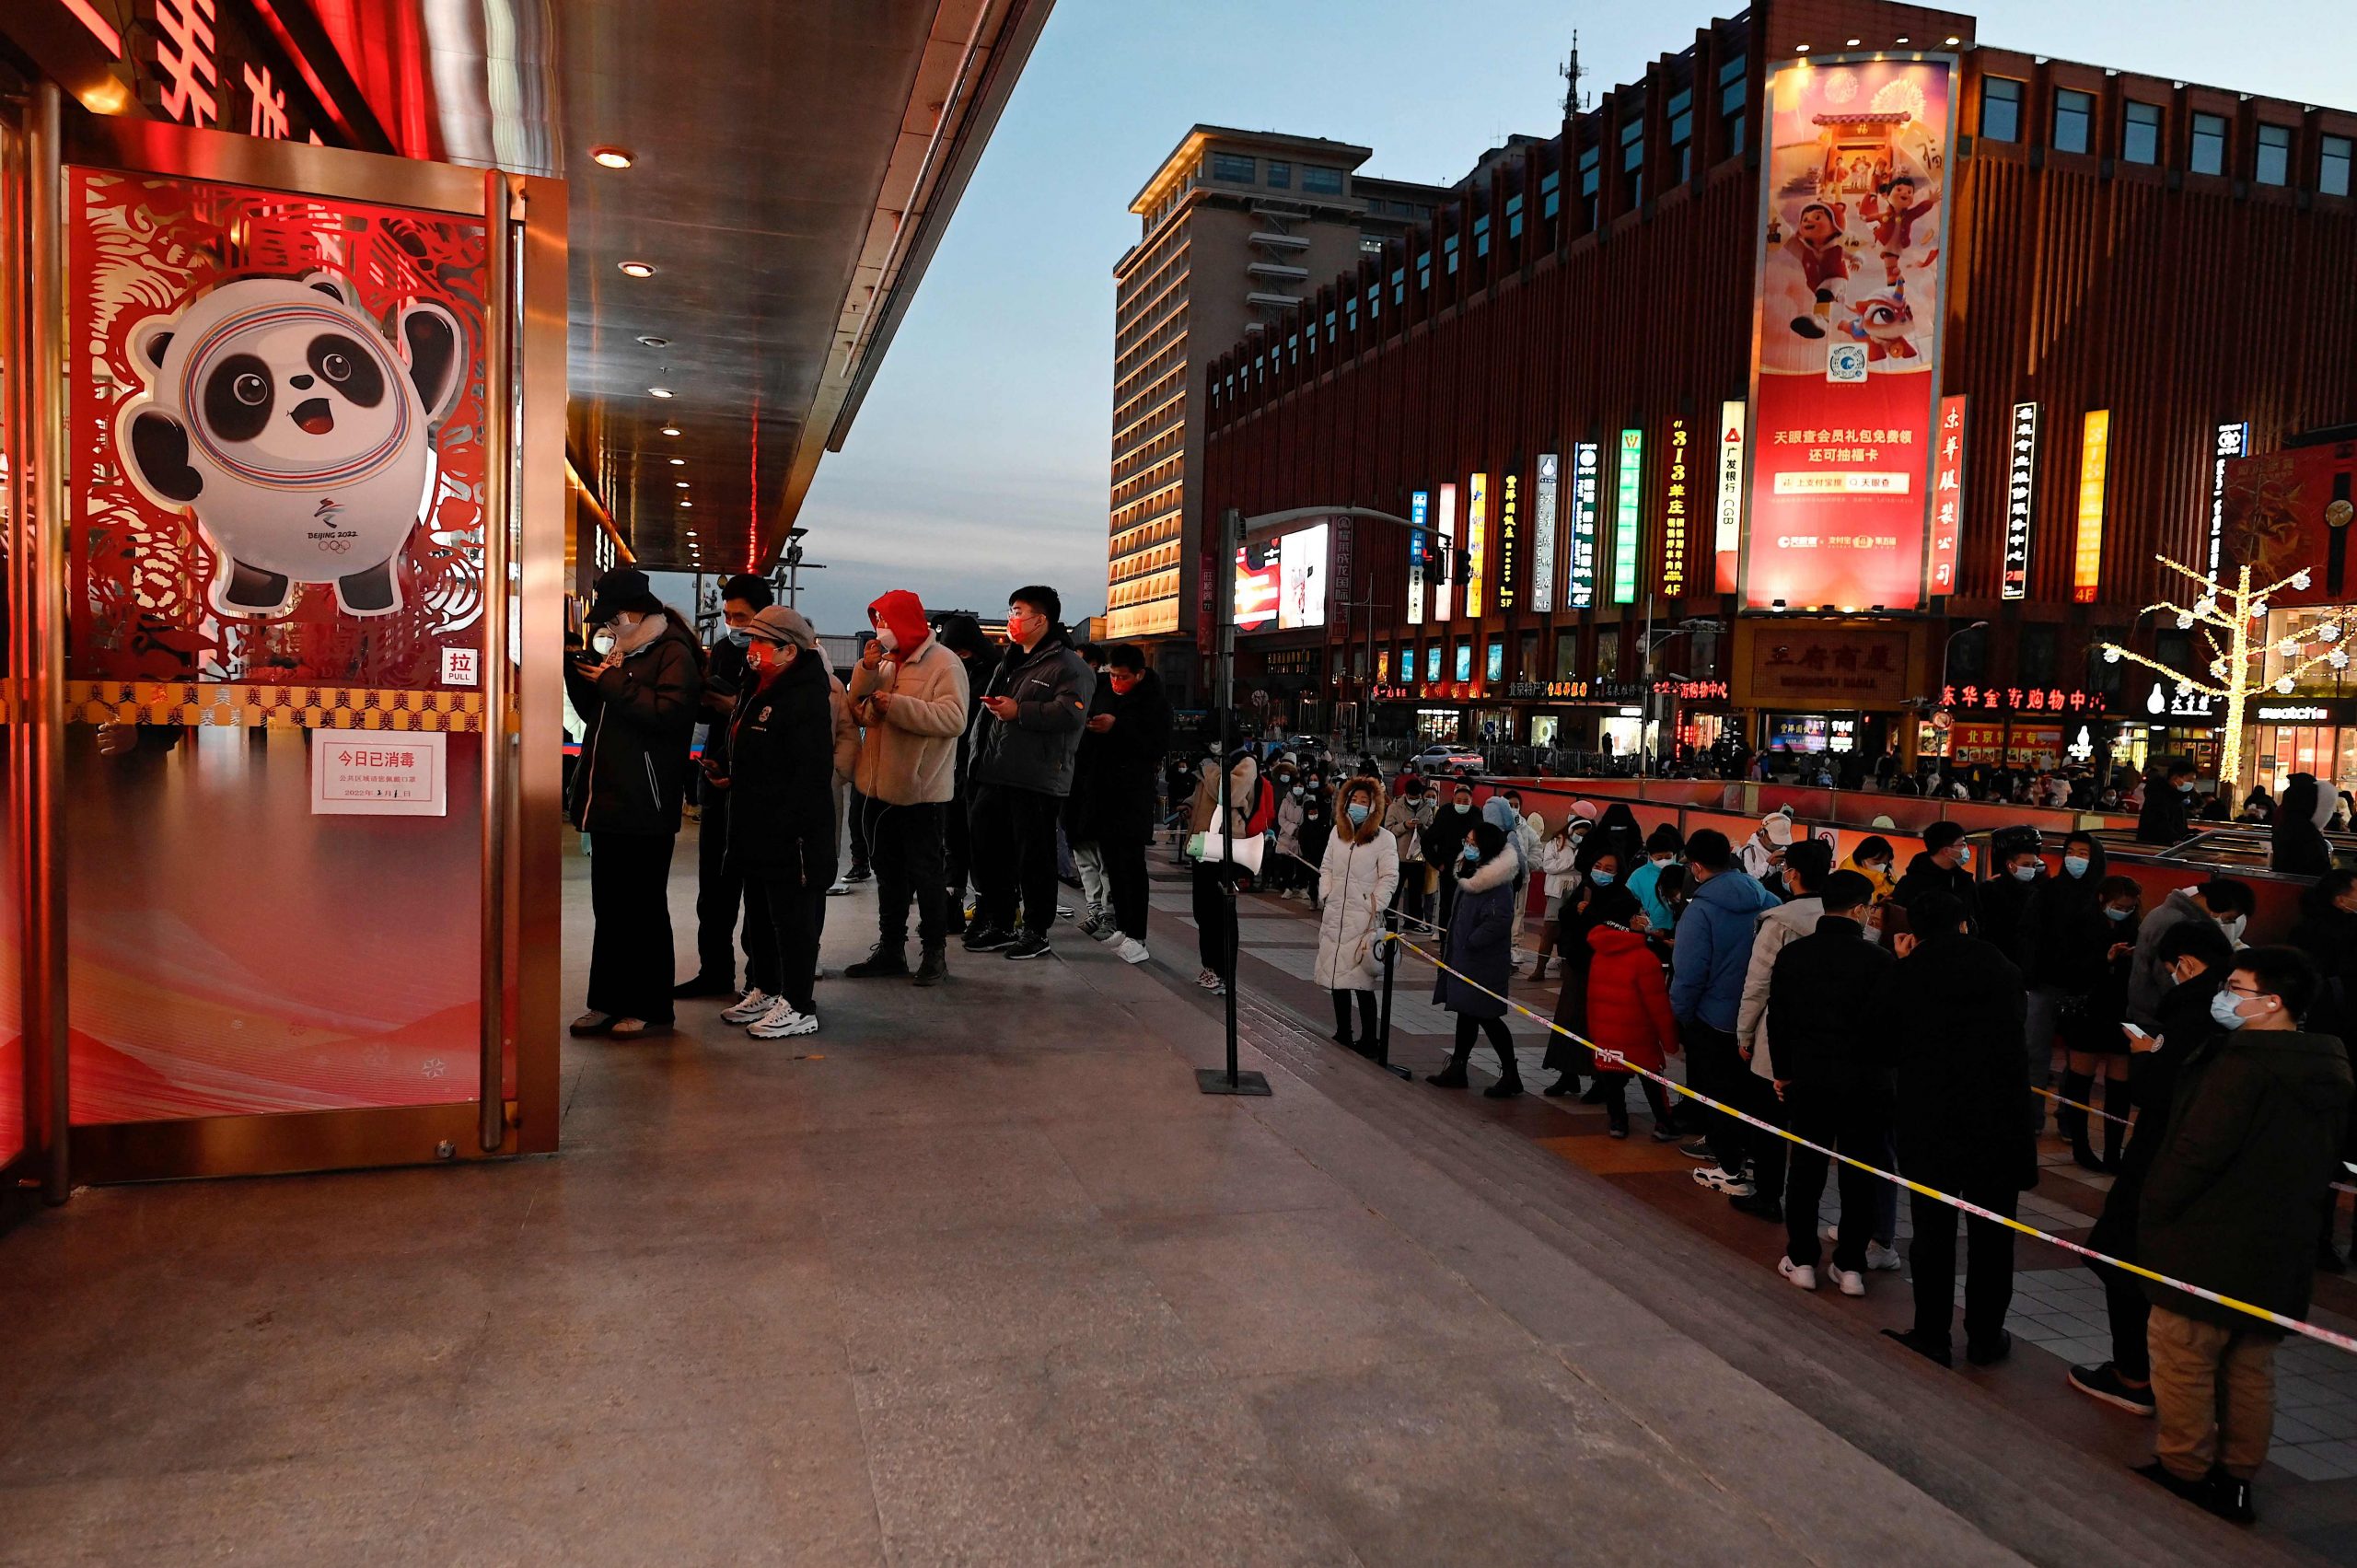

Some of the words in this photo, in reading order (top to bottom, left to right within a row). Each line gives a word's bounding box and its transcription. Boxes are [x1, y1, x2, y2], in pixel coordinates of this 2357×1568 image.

[1774, 429, 1912, 445] 天眼查会员礼包免费领
[1808, 448, 1879, 462] 还可抽福卡
[1725, 447, 1737, 493] 广发银行
[1861, 478, 1890, 488] 天眼查
[1723, 499, 1735, 525] CGB
[308, 532, 335, 540] BEIJING
[1665, 584, 1681, 596] 4F
[2075, 588, 2095, 602] 4F
[1501, 598, 1512, 608] 5F
[449, 653, 471, 672] 拉
[448, 672, 470, 681] PULL
[2258, 706, 2317, 720] swatch
[1967, 729, 2038, 745] 北京产专
[338, 750, 415, 768] 今日已消毒
